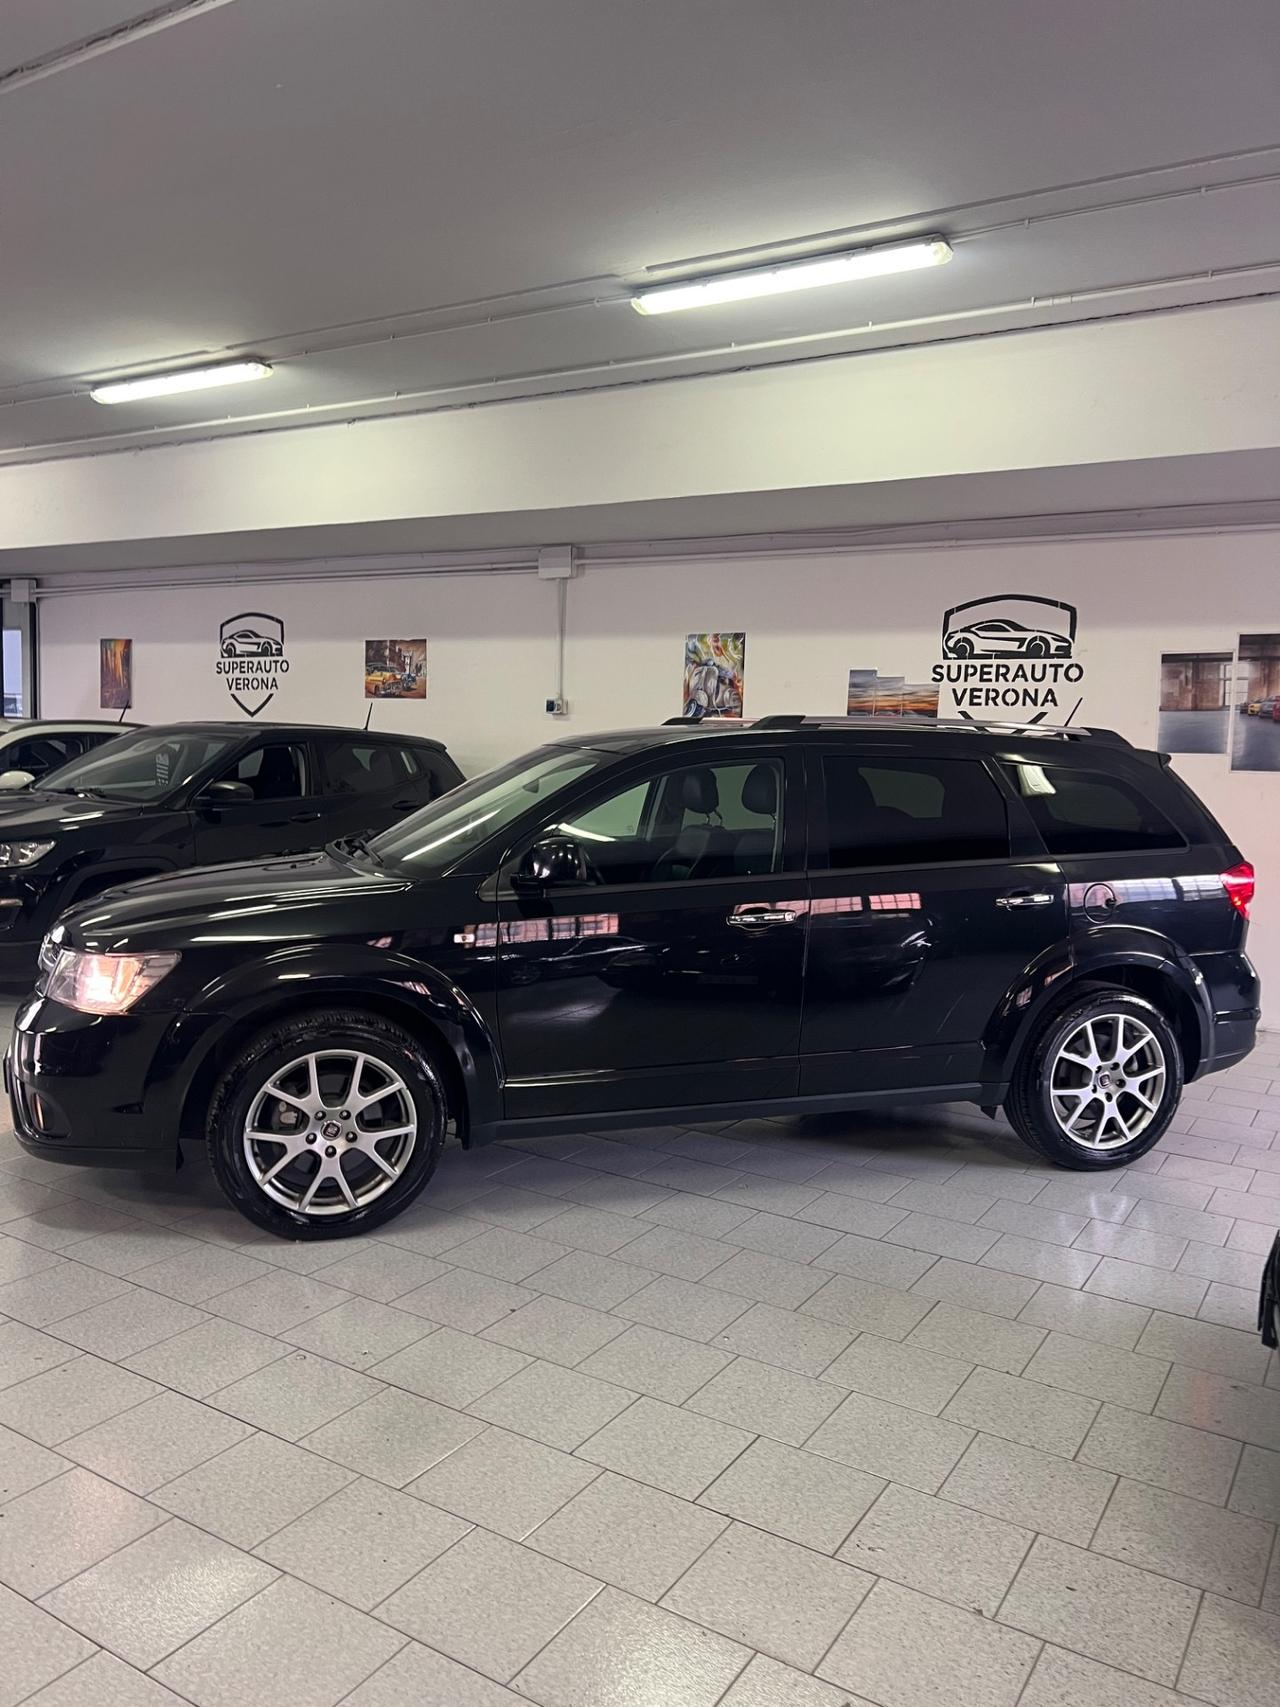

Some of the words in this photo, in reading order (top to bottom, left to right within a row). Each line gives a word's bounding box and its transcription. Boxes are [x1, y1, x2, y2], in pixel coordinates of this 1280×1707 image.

[216, 659, 290, 675] SUPERAUTO
[931, 663, 1084, 683] SUPERAUTO
[226, 677, 279, 691] VERONA
[952, 687, 1058, 707] VERONA
